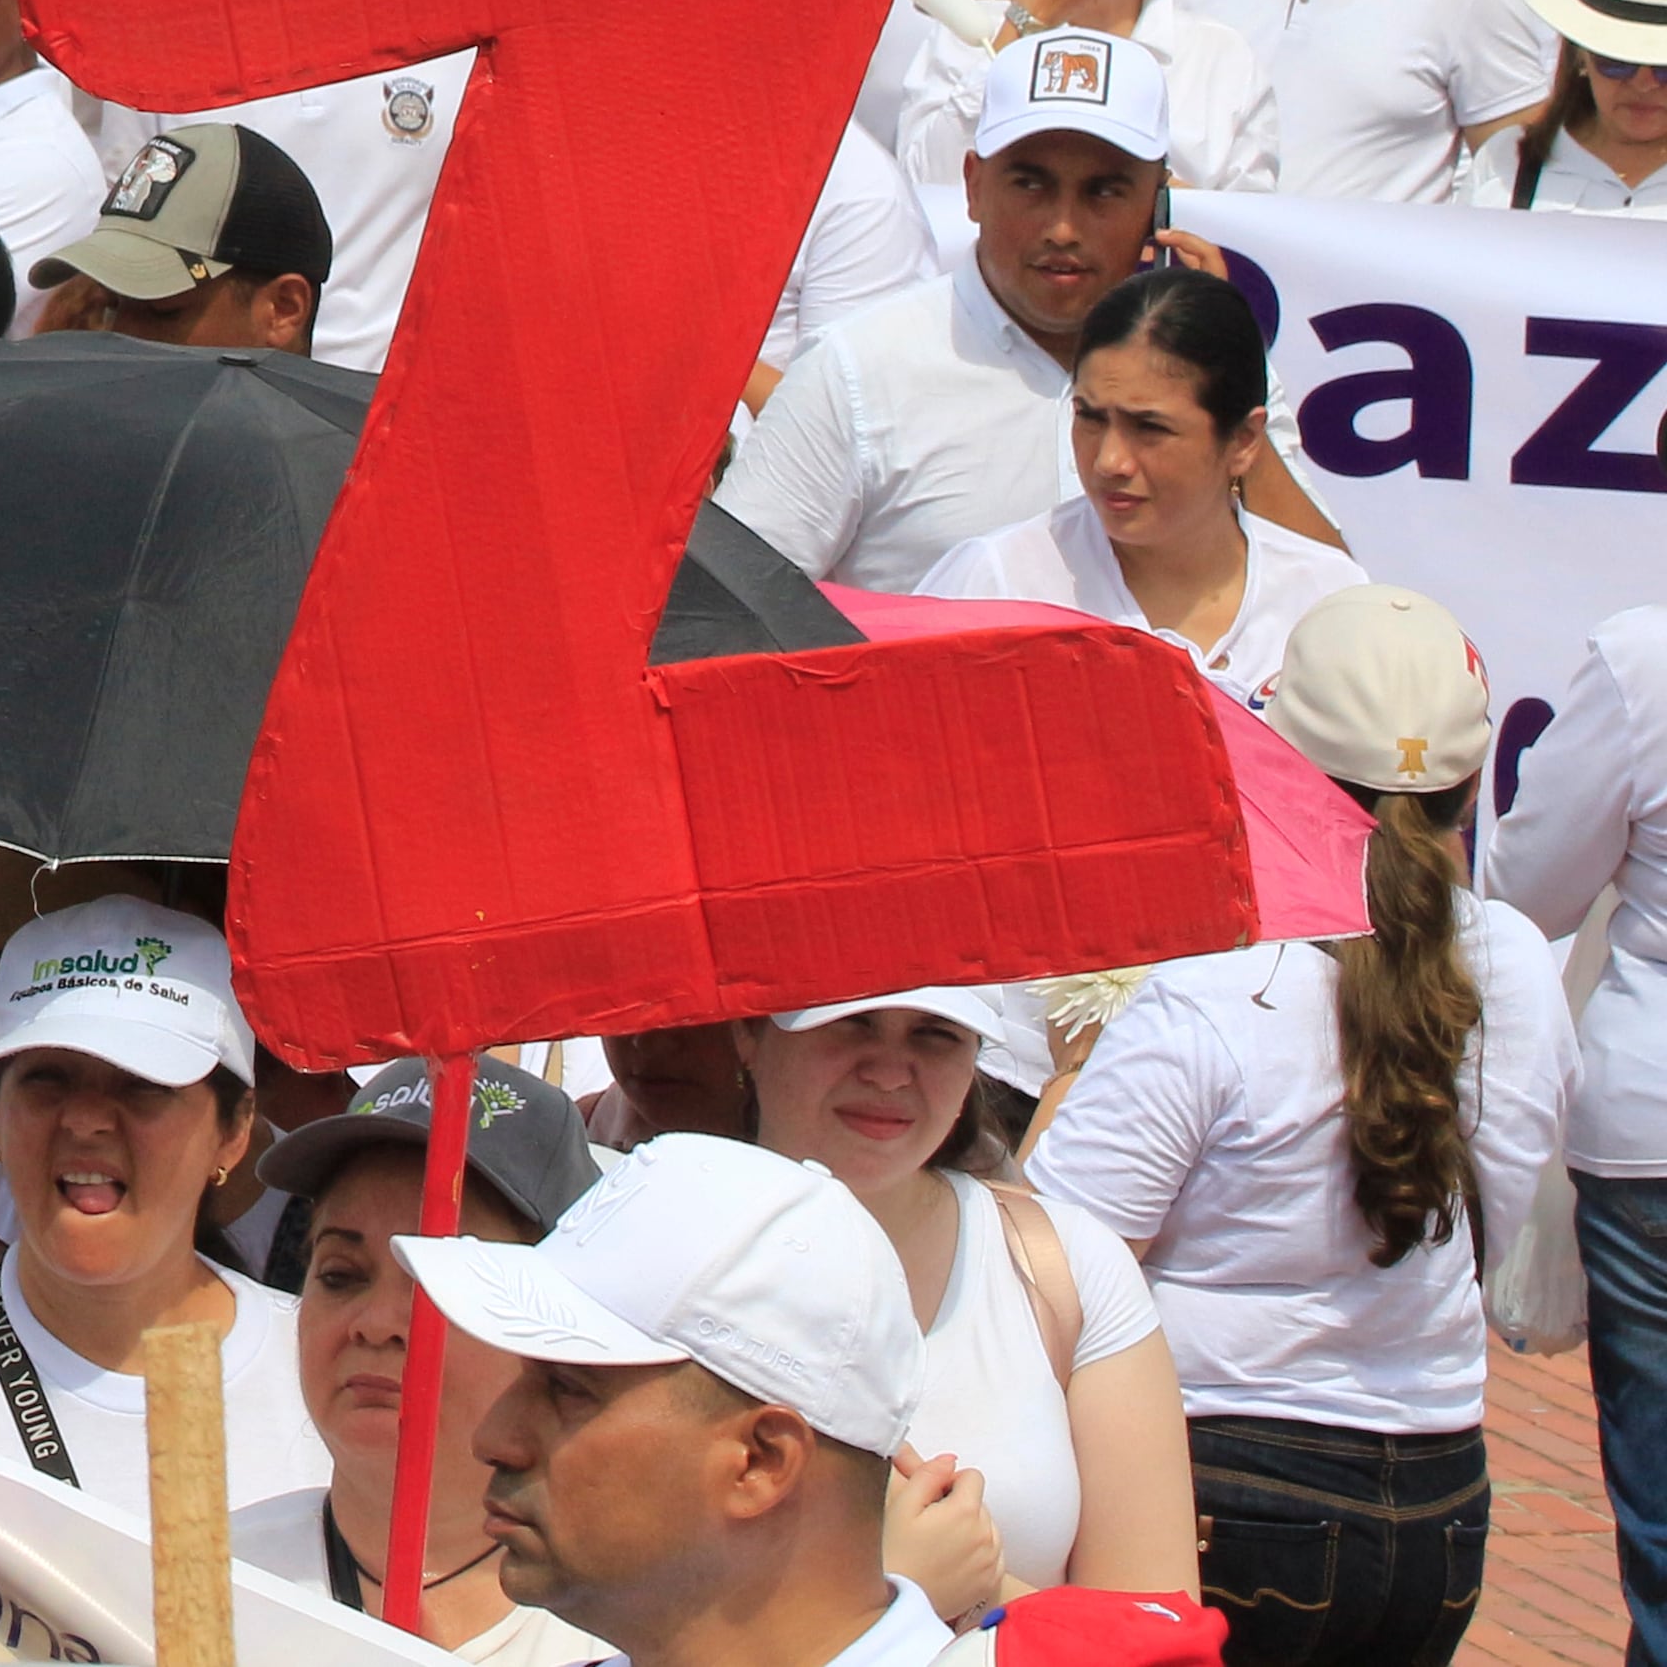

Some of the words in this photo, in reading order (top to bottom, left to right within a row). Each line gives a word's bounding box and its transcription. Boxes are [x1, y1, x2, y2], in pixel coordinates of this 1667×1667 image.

[56, 975, 118, 990] Básicos
[124, 976, 144, 993] de
[149, 982, 190, 1007] Salud
[698, 1316, 806, 1380] COUTURE
[8, 1370, 60, 1461] YOUNG
